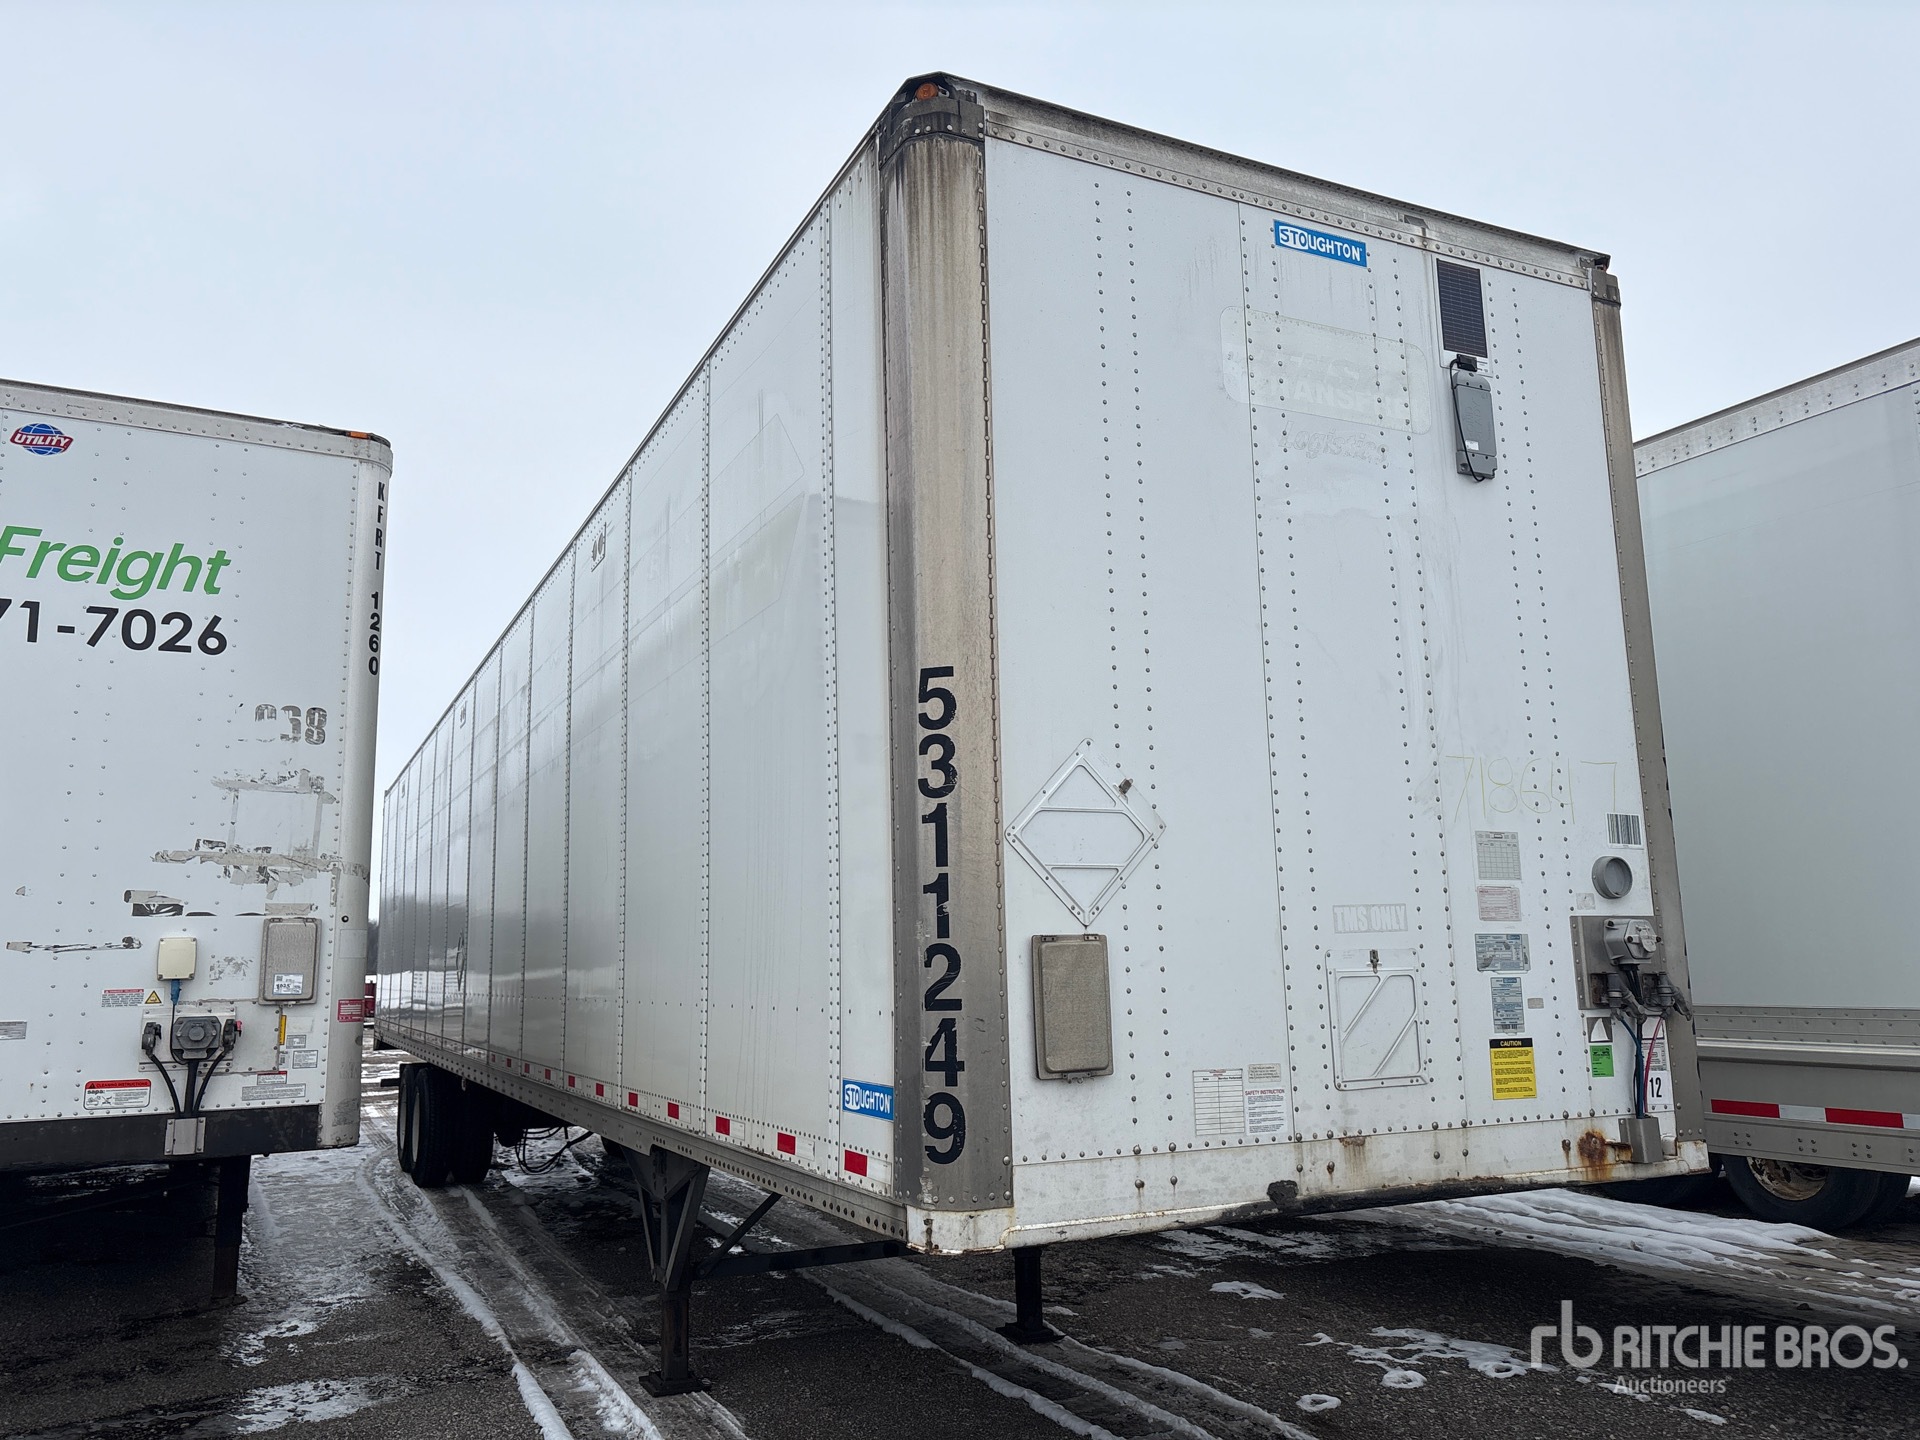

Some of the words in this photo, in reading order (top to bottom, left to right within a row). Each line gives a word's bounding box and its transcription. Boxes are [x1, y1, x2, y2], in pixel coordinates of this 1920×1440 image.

[1279, 226, 1362, 262] STOUGHTON
[14, 433, 69, 447] UTILITY
[0, 525, 232, 600] Freight
[368, 591, 381, 676] 1260
[917, 666, 966, 1166] 5311249
[1333, 905, 1369, 932] TMS
[845, 1085, 892, 1114] STOUGHTON
[1649, 1077, 1662, 1098] 12
